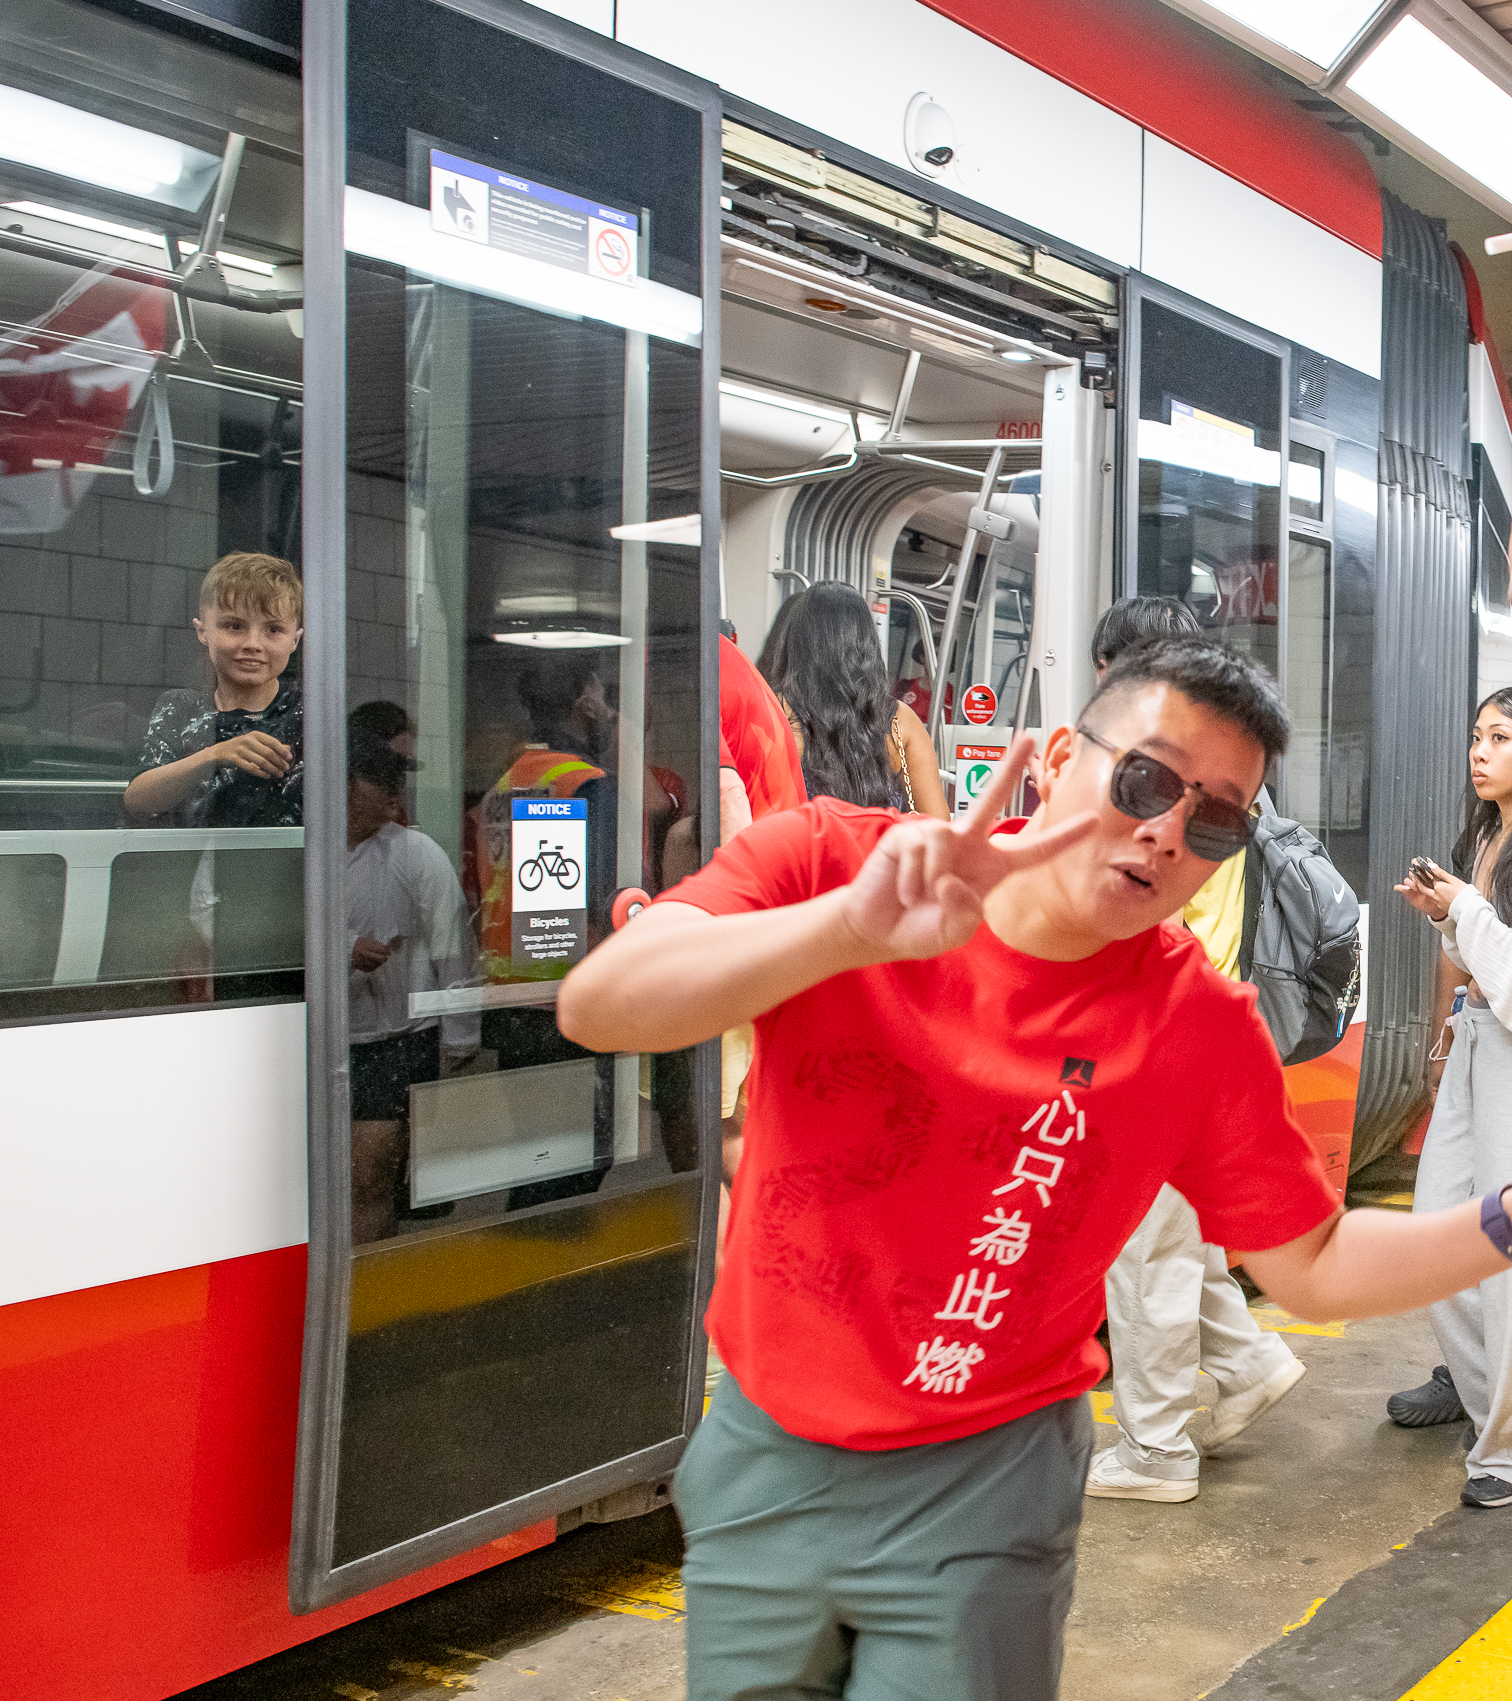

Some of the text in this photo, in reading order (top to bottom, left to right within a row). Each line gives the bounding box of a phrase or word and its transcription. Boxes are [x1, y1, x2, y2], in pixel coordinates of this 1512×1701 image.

[498, 175, 529, 192] NOTICE
[599, 208, 627, 224] NOTICE
[996, 421, 1040, 439] 4600
[972, 749, 1001, 758] Pay fare
[528, 803, 571, 815] NOTICE
[530, 917, 569, 929] Bicycles
[902, 1089, 1085, 1394] 心只為此燃
